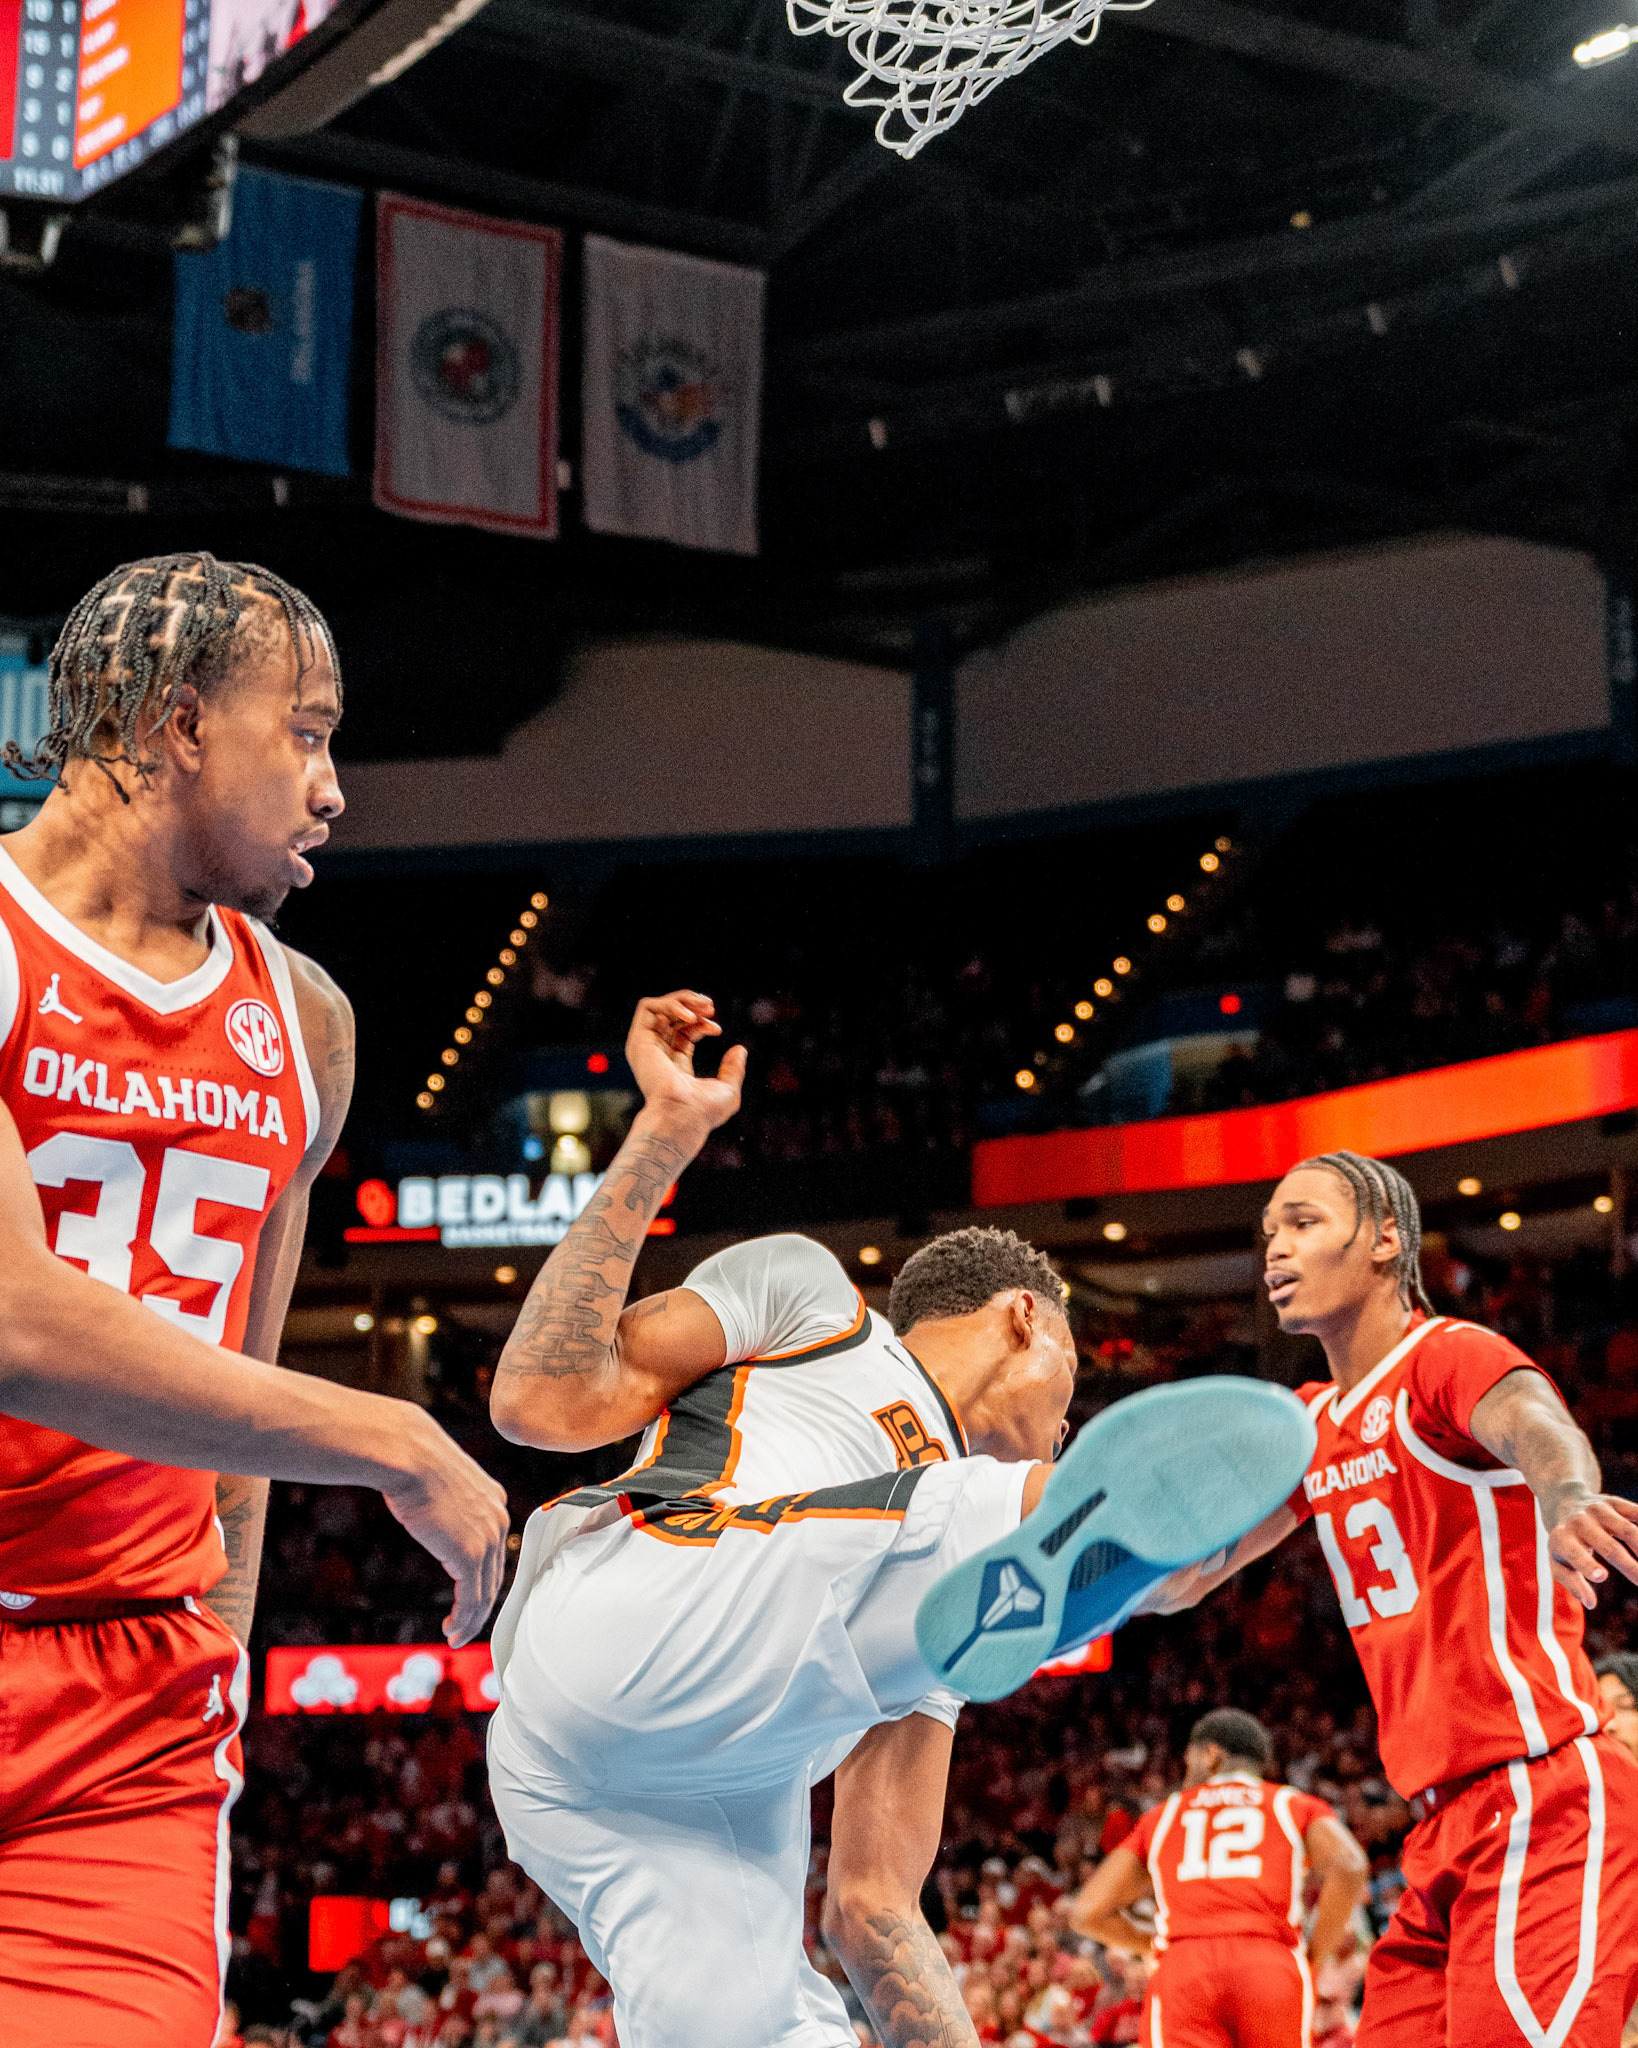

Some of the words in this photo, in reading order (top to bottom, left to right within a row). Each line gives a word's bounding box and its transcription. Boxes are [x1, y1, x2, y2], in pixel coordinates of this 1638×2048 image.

[230, 1002, 282, 1073] SEC
[23, 1046, 289, 1146] OKLAHOMA
[27, 1131, 271, 1346] 35
[1315, 1497, 1420, 1628] 13
[1177, 1806, 1265, 1882] 12
